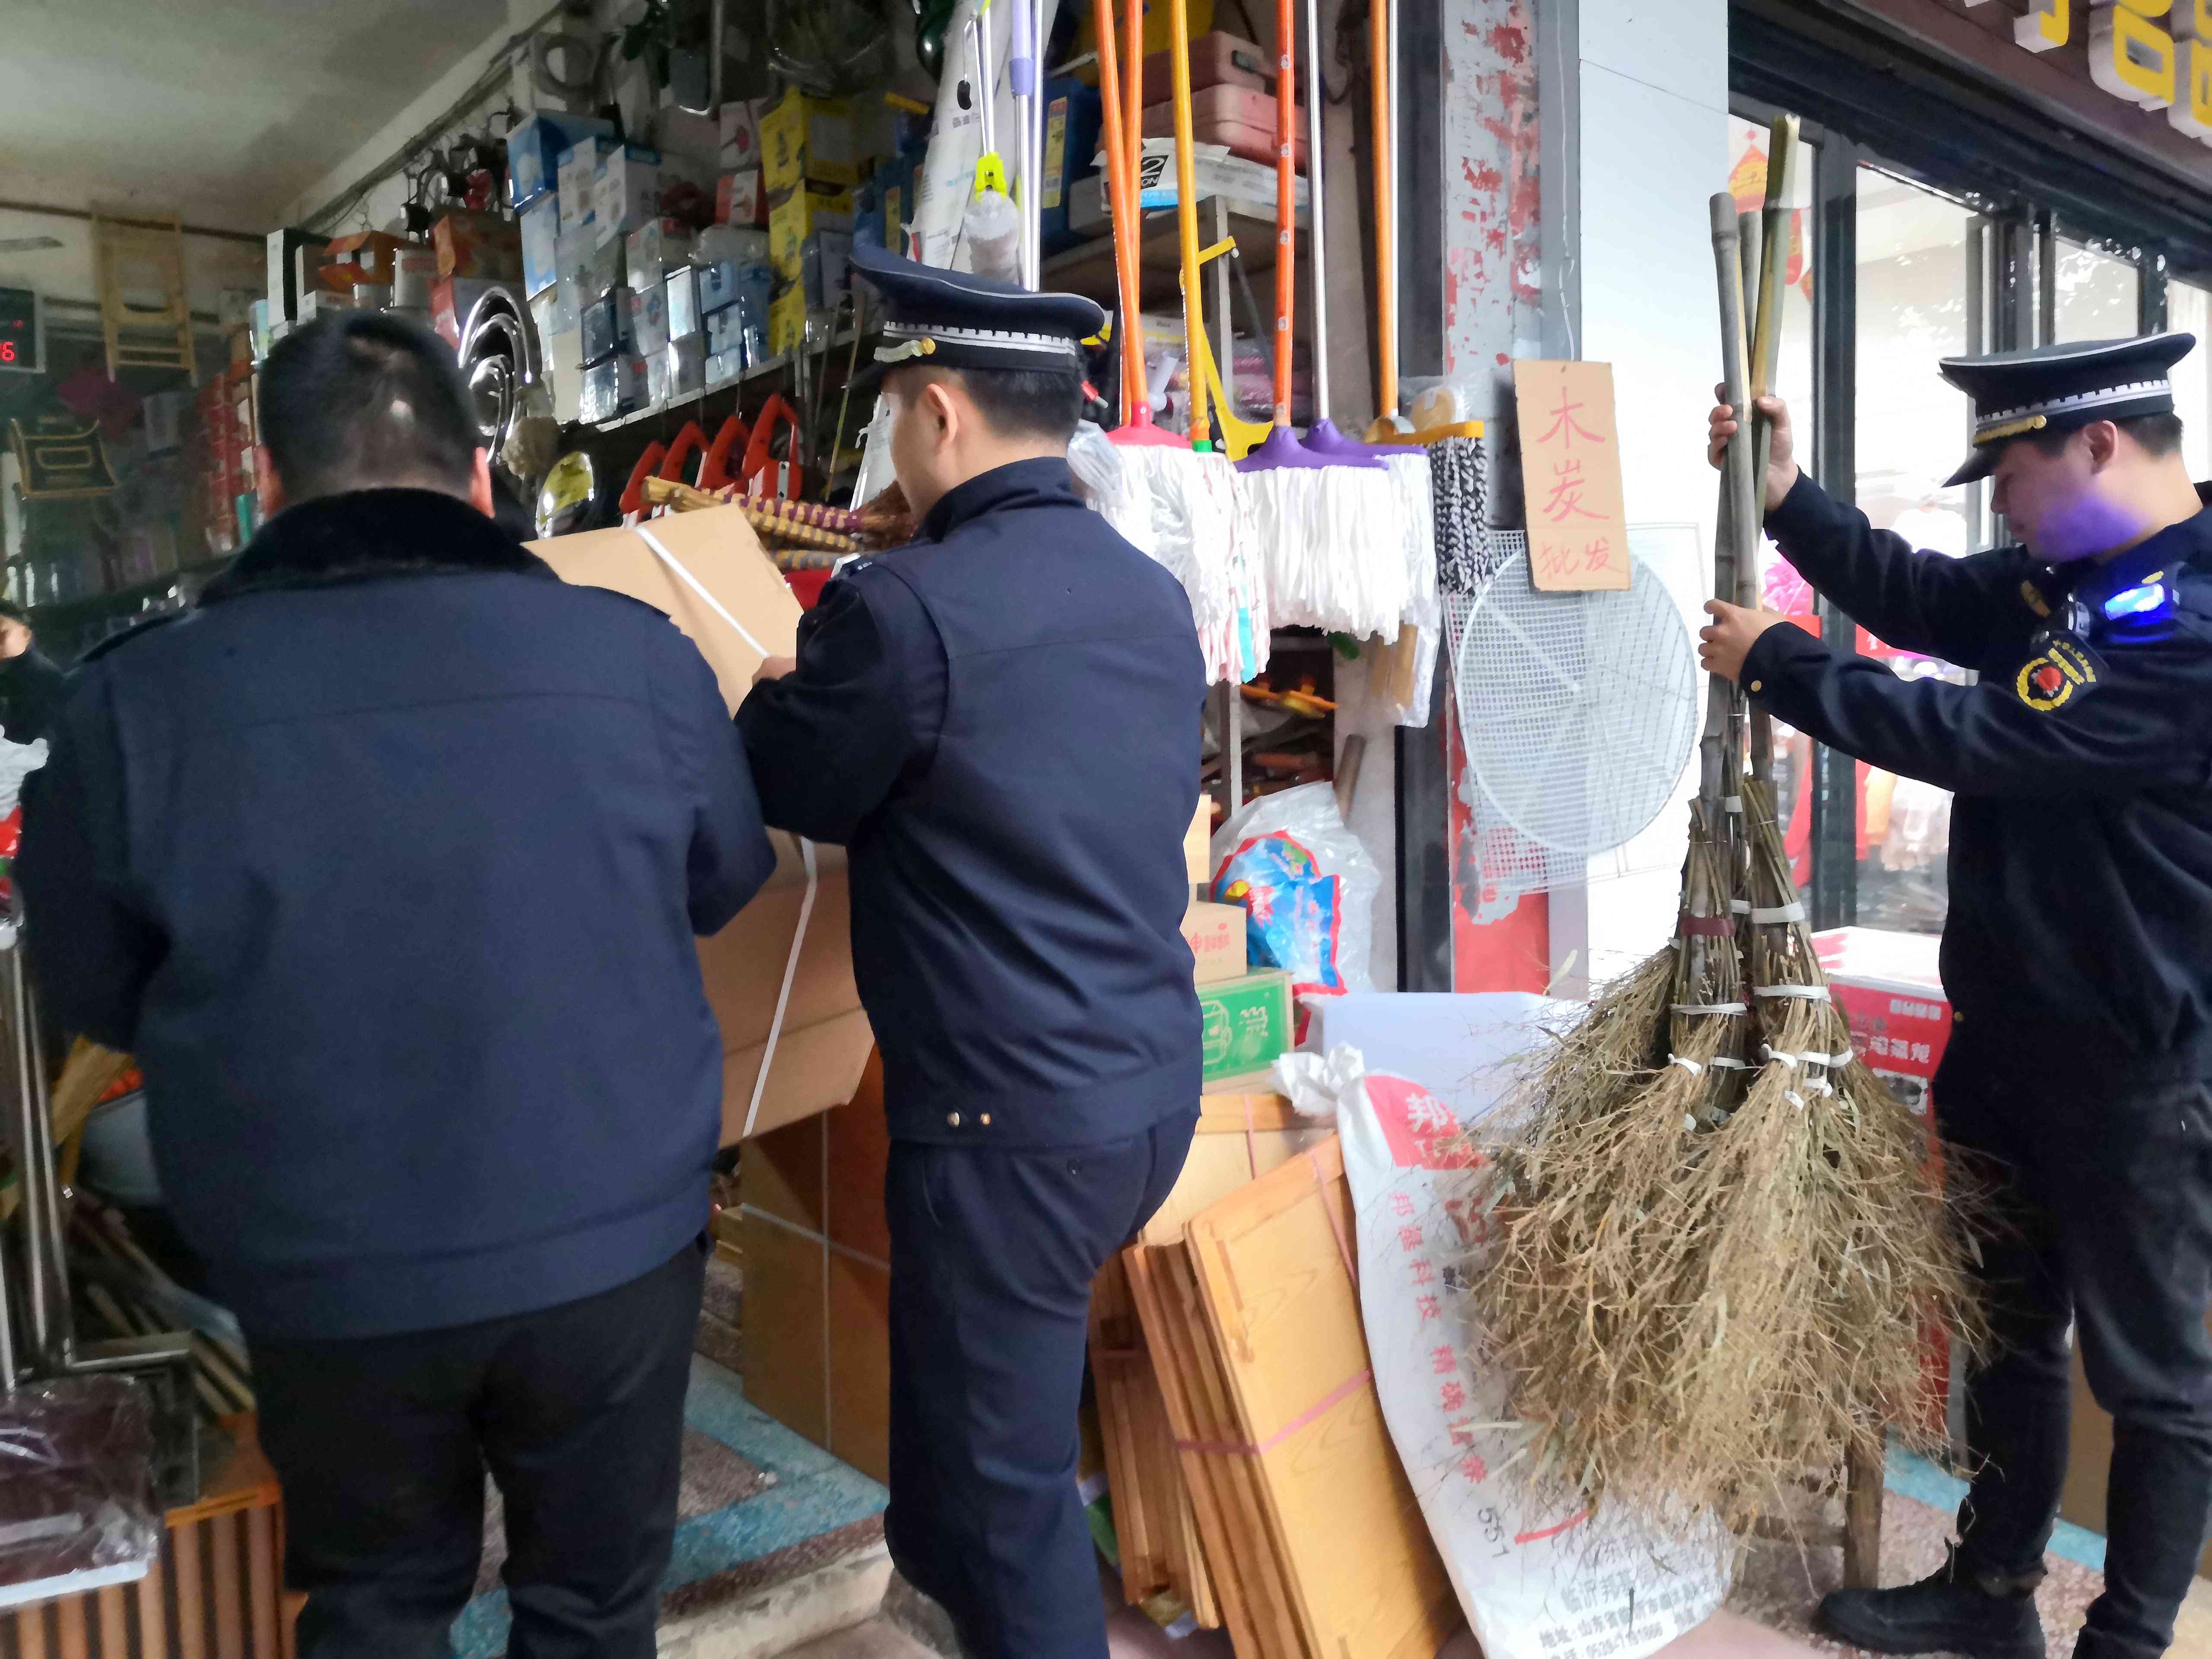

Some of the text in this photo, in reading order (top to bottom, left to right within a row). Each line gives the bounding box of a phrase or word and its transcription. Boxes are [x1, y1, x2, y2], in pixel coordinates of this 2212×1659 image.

[1141, 177, 1159, 186] ON
[0, 341, 14, 361] 6
[1536, 386, 1611, 522] 木炭
[1538, 537, 1624, 581] 批发
